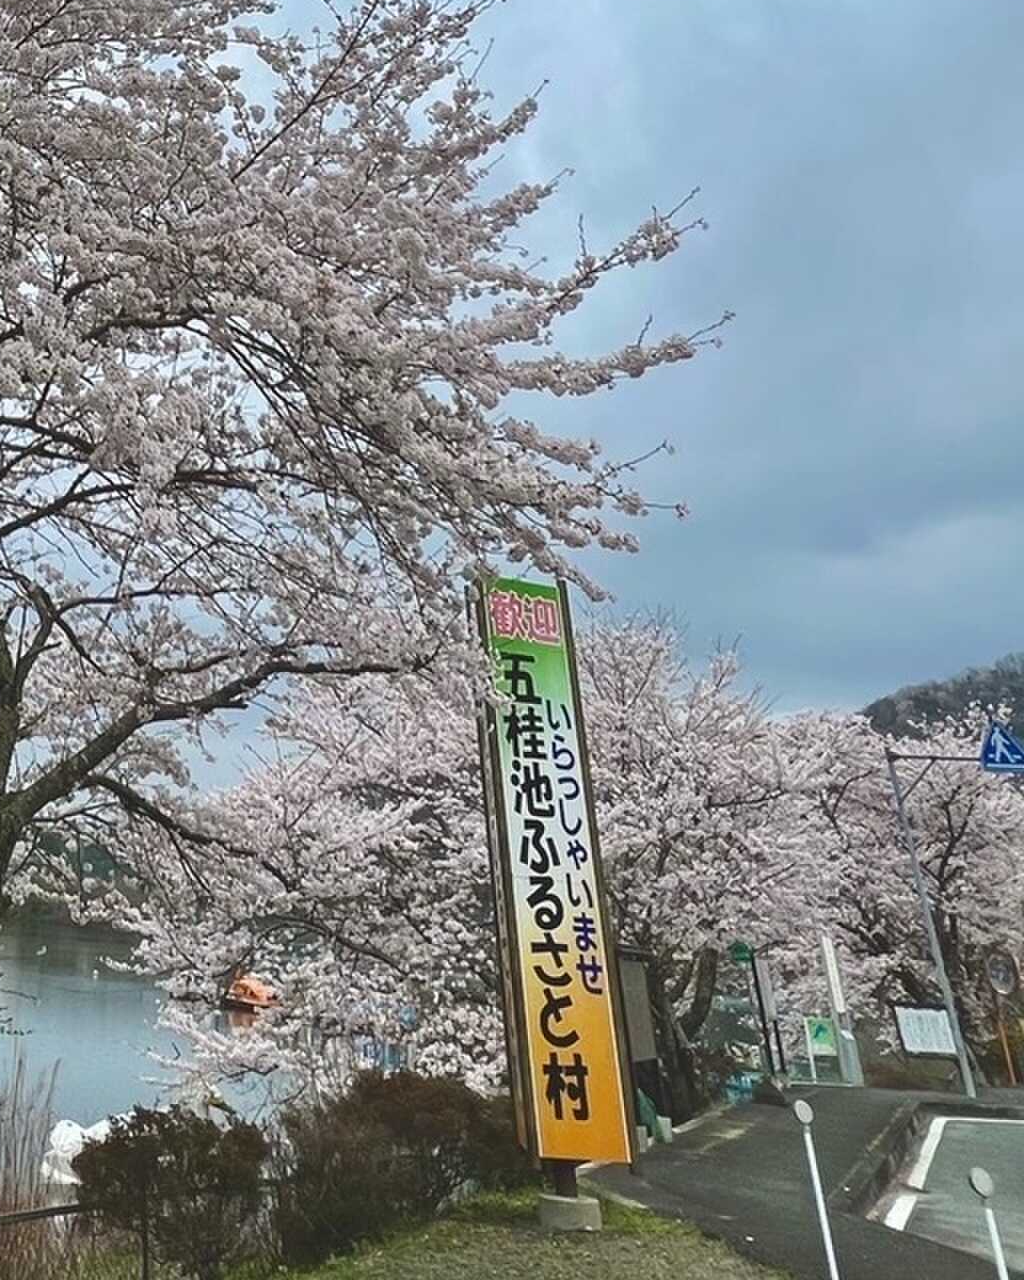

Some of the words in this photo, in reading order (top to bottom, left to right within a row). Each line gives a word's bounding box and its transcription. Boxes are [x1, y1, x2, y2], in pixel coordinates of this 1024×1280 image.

[488, 591, 561, 644] 歓迎
[500, 651, 589, 1121] 五桂池ふるさと村
[546, 699, 604, 995] いらっしゃいませ
